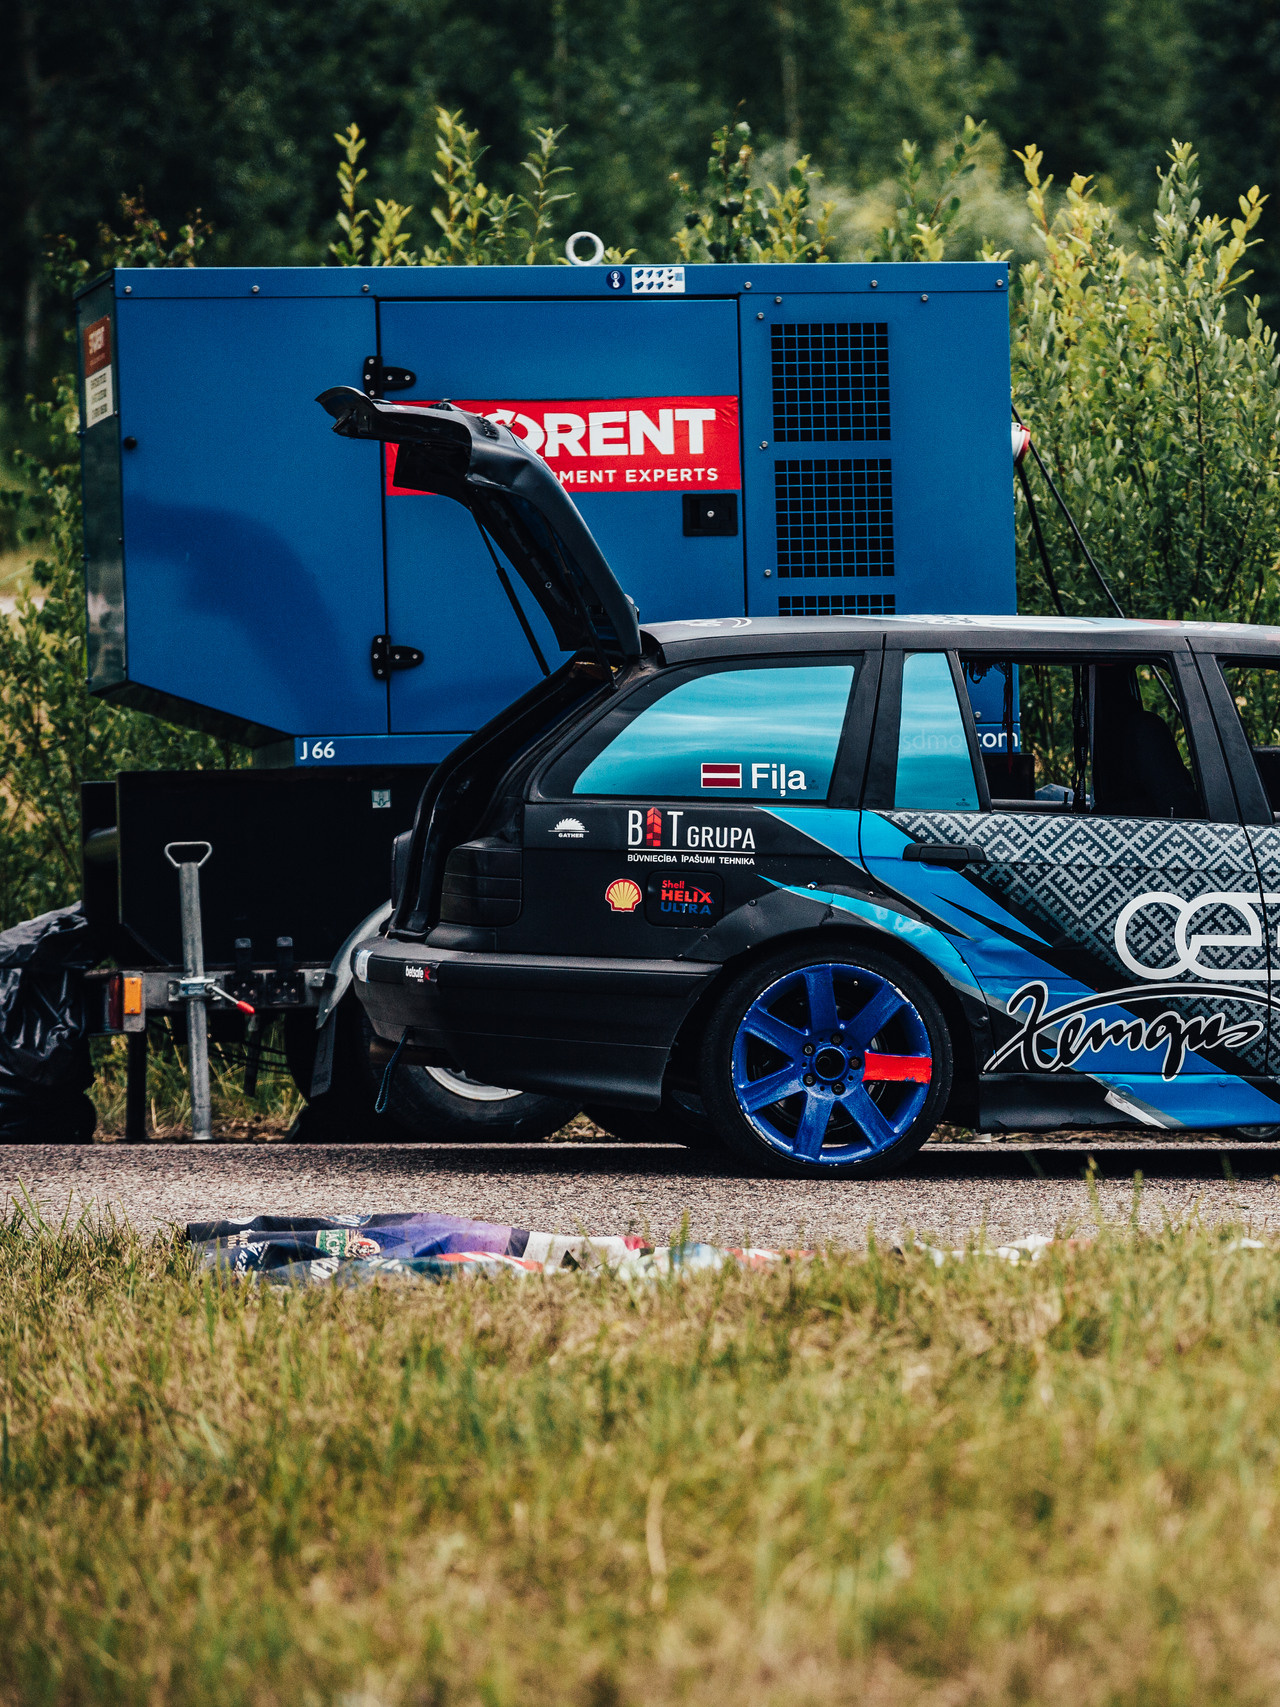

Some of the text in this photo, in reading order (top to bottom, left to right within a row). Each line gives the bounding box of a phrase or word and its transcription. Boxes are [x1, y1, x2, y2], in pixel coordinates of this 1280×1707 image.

[480, 408, 716, 458] ORENT
[553, 467, 719, 485] MENT EXPERTS
[311, 740, 336, 759] 66
[751, 762, 807, 797] Fiļa
[686, 825, 756, 850] GRUPA
[627, 853, 756, 866] BŪVNIECĪBA ĪPAŠUMI TEHNIKA
[661, 879, 685, 889] Shell
[660, 889, 713, 904] HELIX
[660, 901, 712, 915] ULTRA
